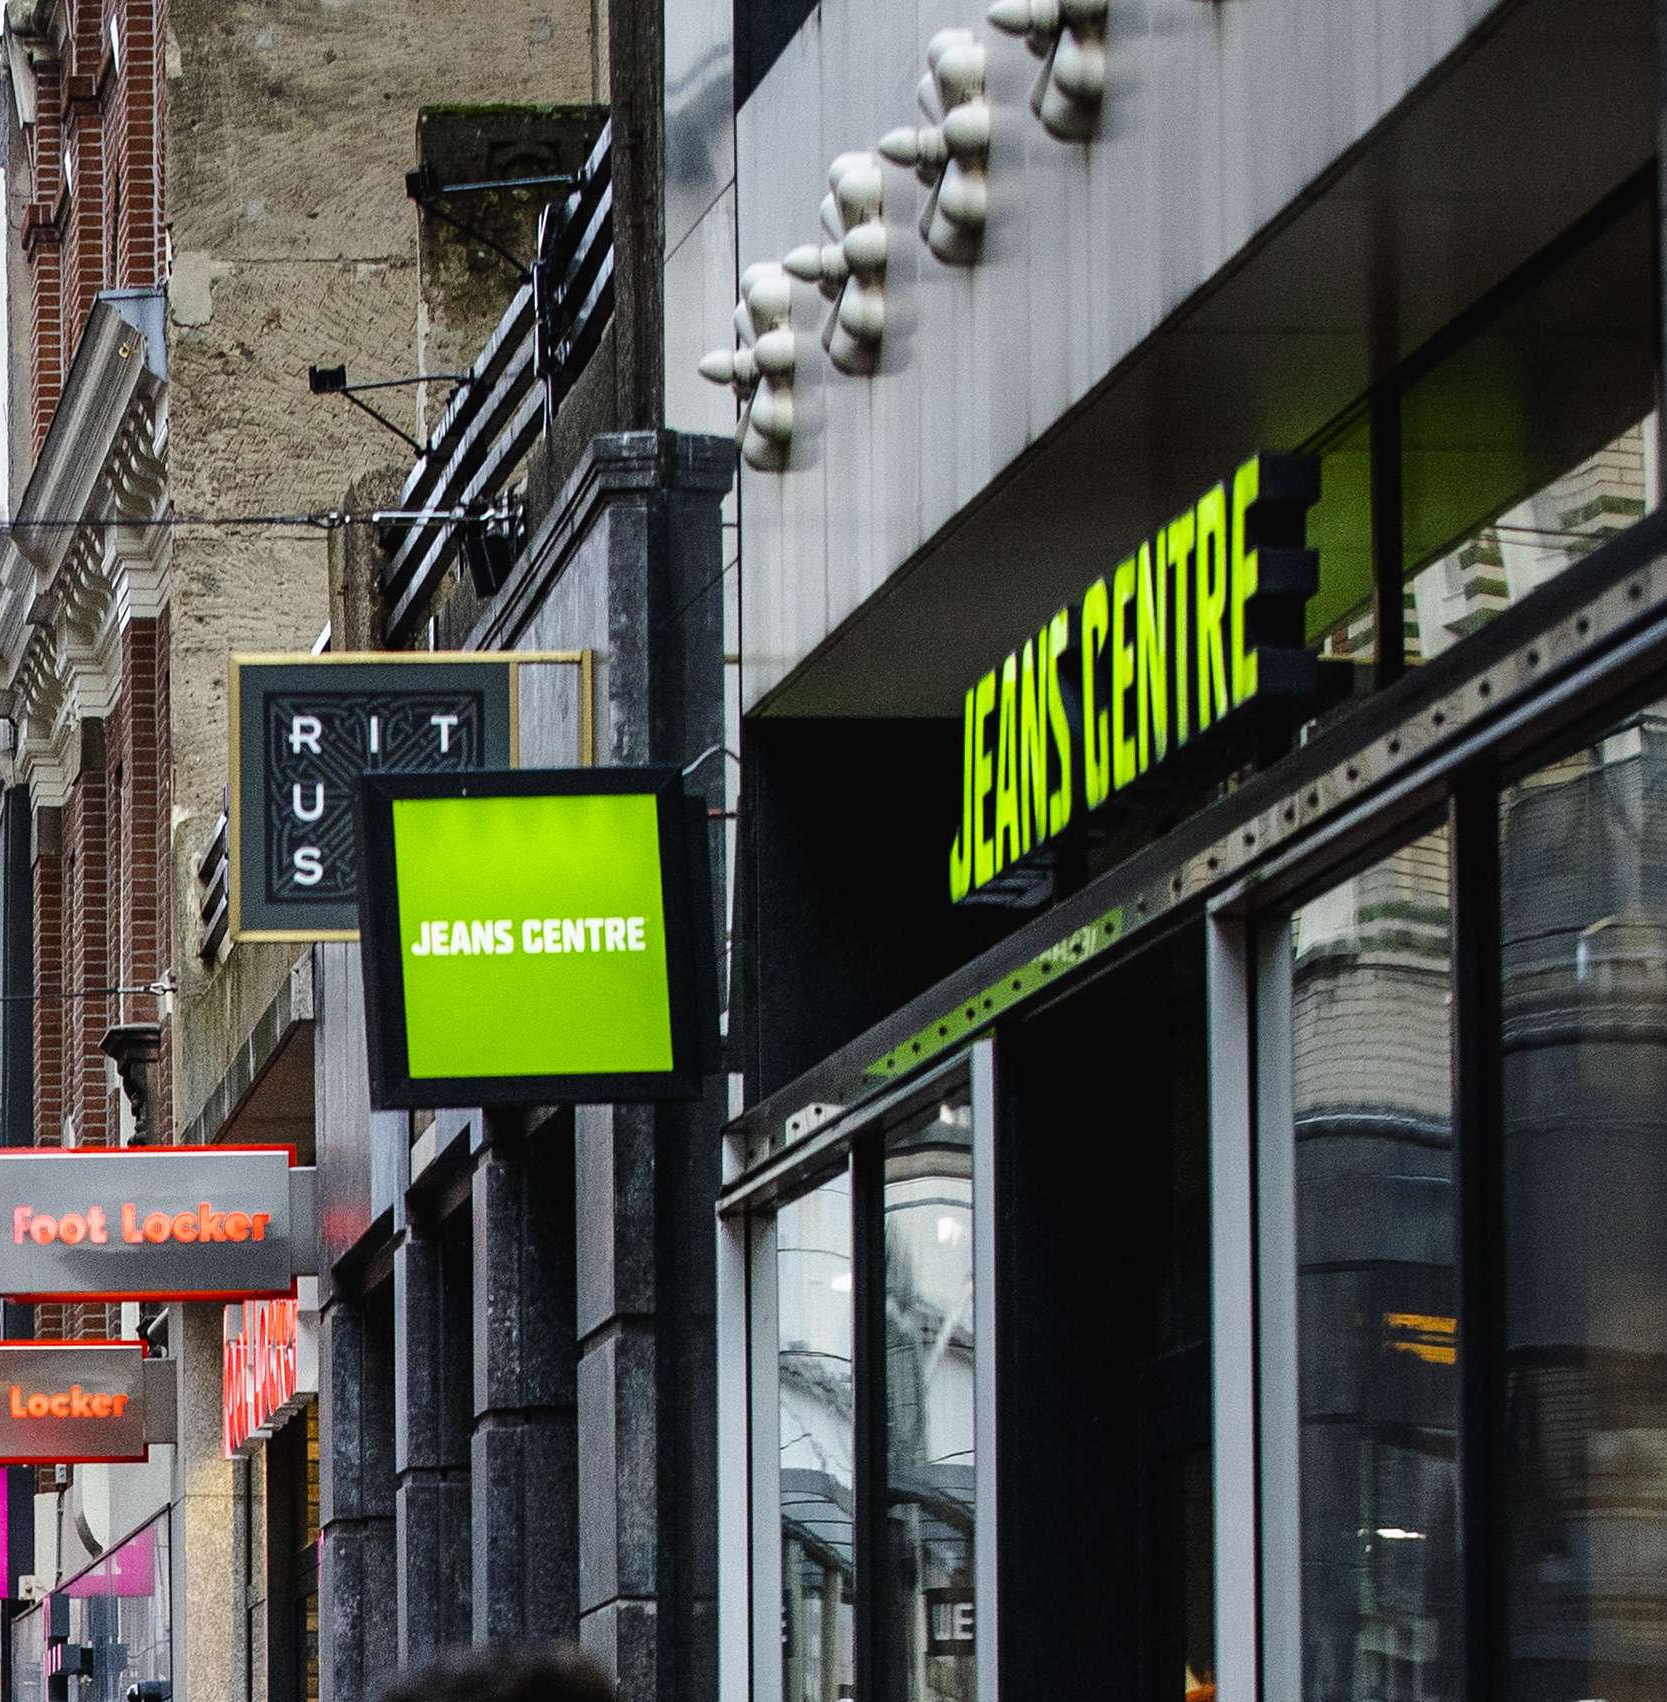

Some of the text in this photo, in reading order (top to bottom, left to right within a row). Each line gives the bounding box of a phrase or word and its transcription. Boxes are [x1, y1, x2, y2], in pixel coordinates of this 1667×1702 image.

[950, 455, 1259, 904] JEANS CENTRE
[411, 916, 647, 956] JEANS CENTRE
[14, 1202, 270, 1244] Foot Locker
[11, 1384, 129, 1420] Locker
